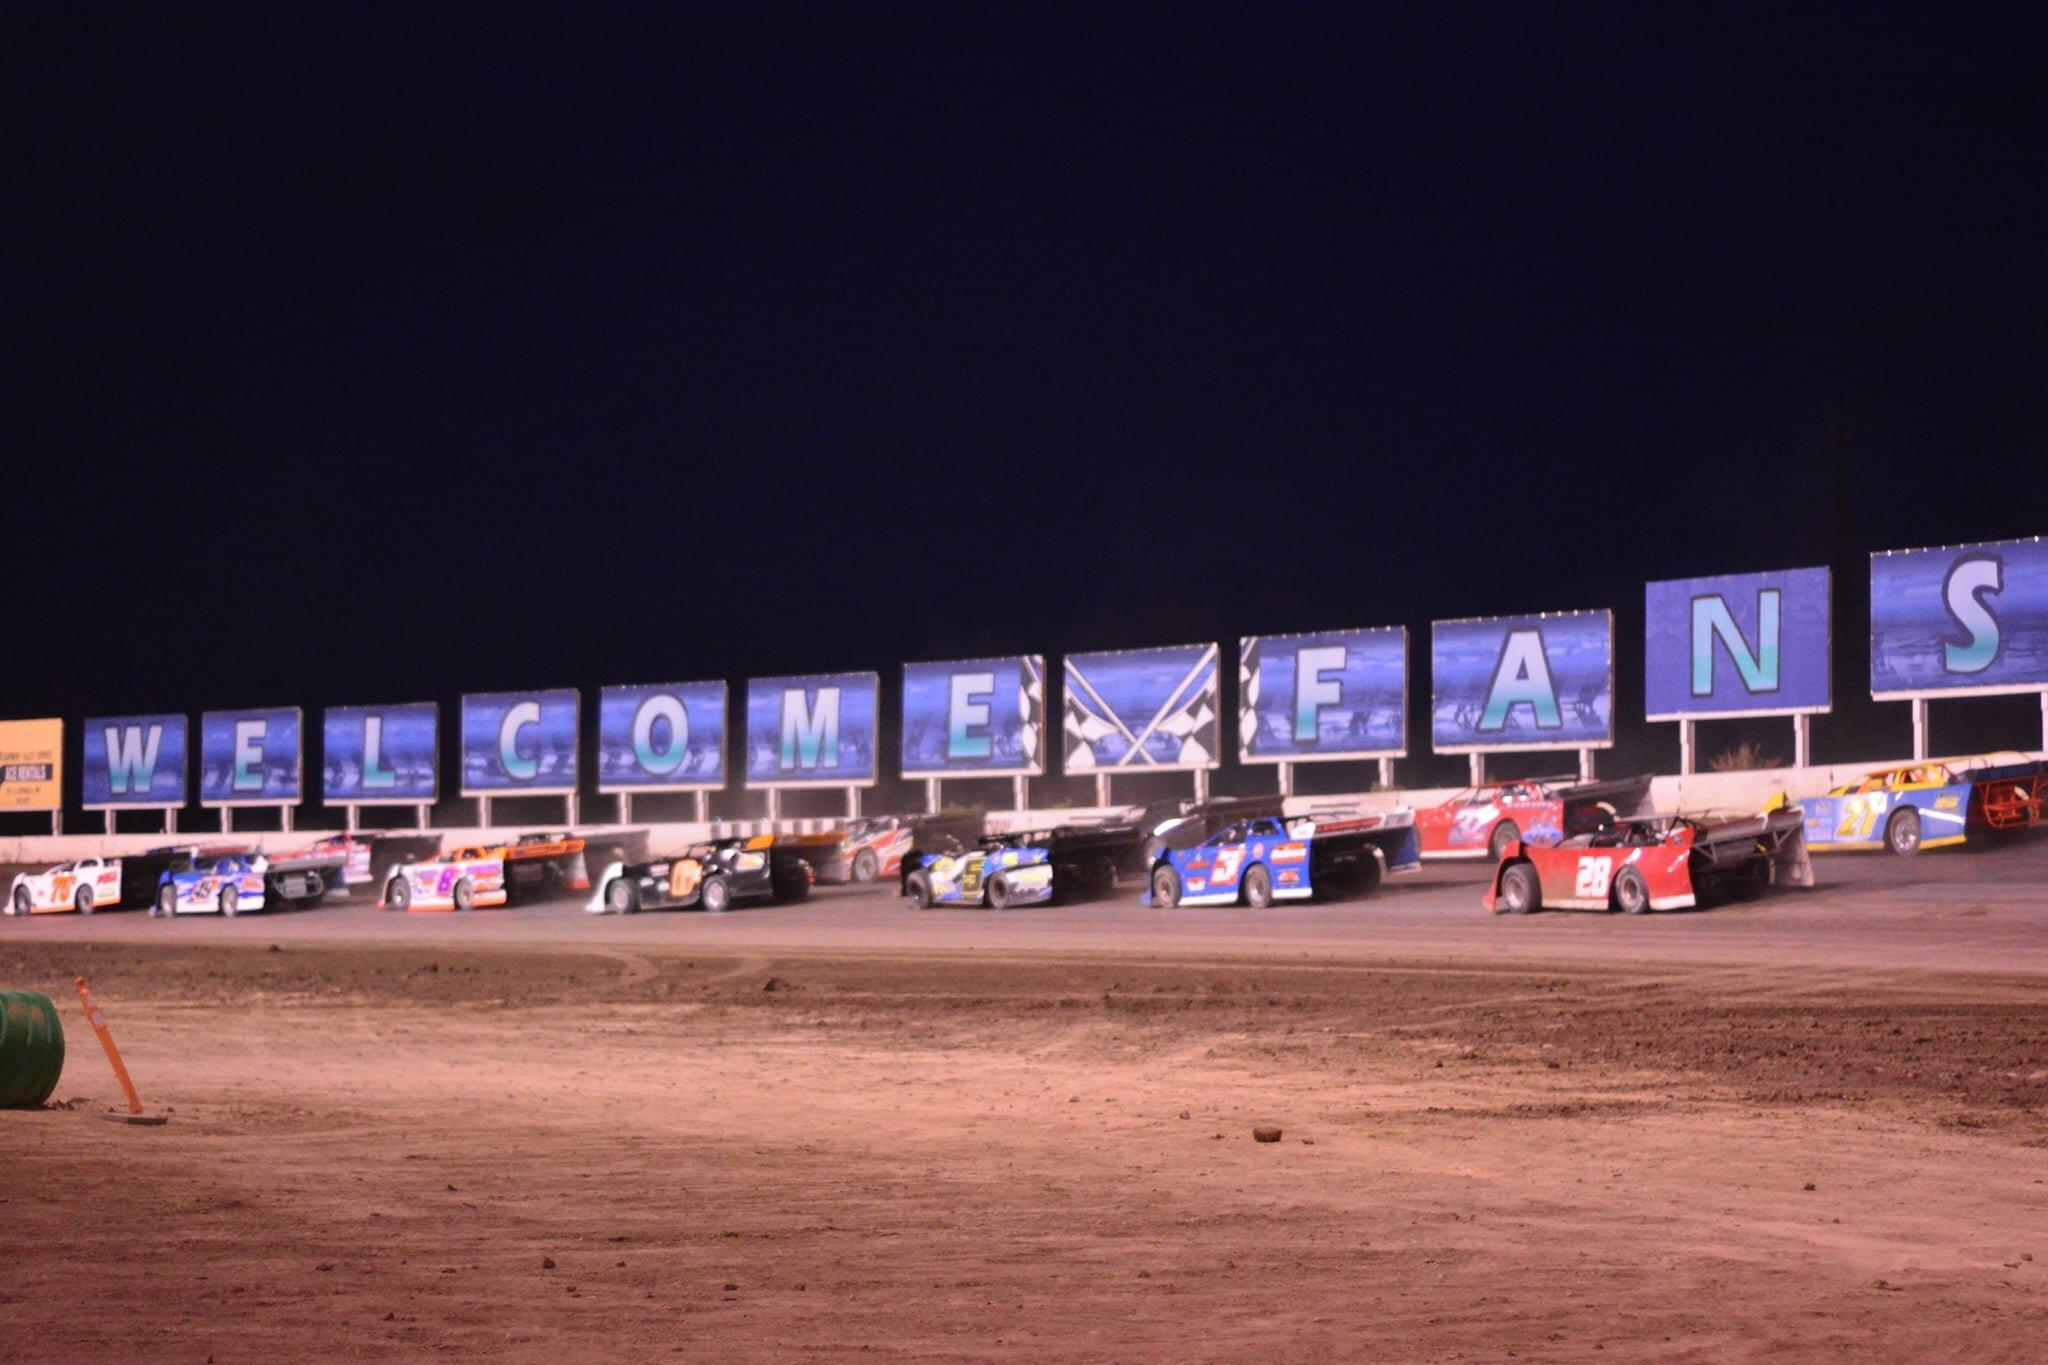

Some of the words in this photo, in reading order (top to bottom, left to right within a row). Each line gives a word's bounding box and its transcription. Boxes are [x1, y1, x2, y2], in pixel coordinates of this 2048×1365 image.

[1294, 645, 1347, 742] F
[1476, 627, 1563, 733] A
[1691, 588, 1781, 697] N
[1942, 553, 2003, 675] S
[104, 724, 163, 794] W
[234, 719, 268, 791] E
[361, 715, 397, 789] L
[500, 700, 541, 781] C
[632, 693, 690, 776] O
[779, 686, 841, 770] M
[947, 671, 995, 758] E
[1211, 847, 1243, 884] 3
[1575, 855, 1612, 898] 28
